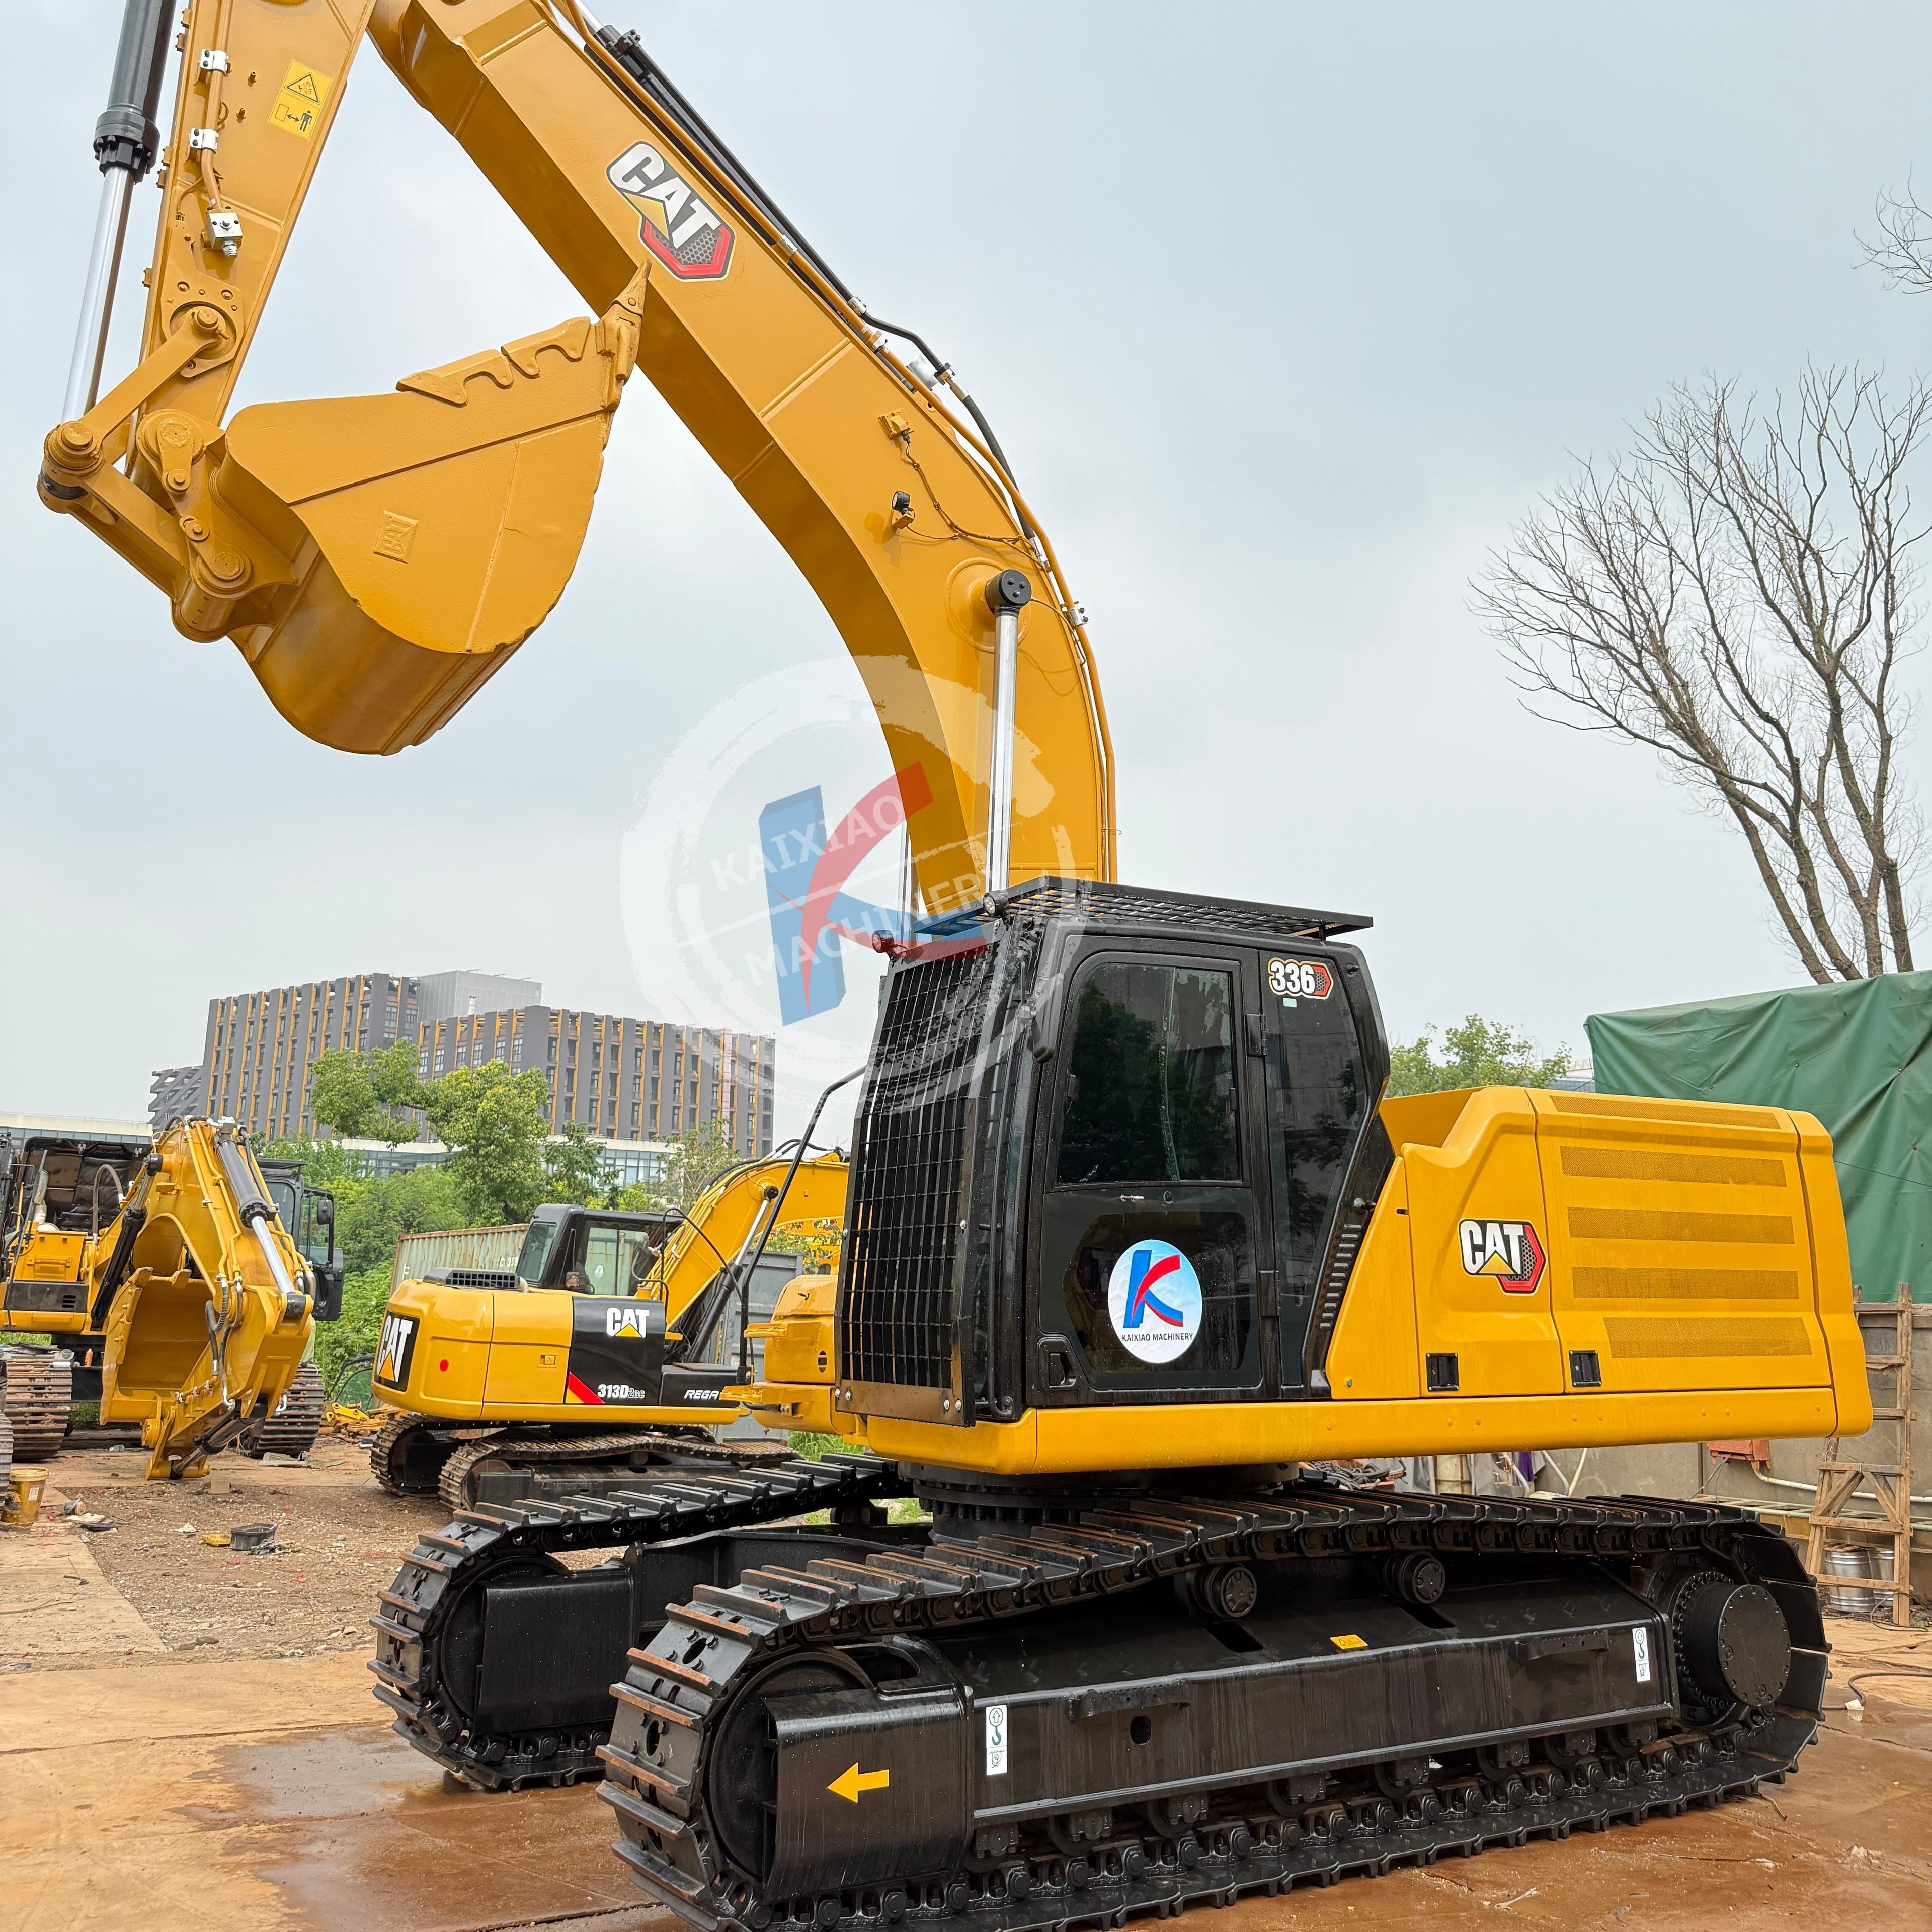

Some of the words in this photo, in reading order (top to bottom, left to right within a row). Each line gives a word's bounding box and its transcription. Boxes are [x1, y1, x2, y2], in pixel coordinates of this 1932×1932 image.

[609, 143, 721, 249] CAT
[1271, 961, 1315, 994] 336
[1460, 1220, 1524, 1275] CAT
[606, 1307, 650, 1338] CAT
[1122, 1333, 1151, 1342] KAIXIAO
[1153, 1333, 1193, 1341] MACHINERY
[377, 1315, 413, 1383] CAT
